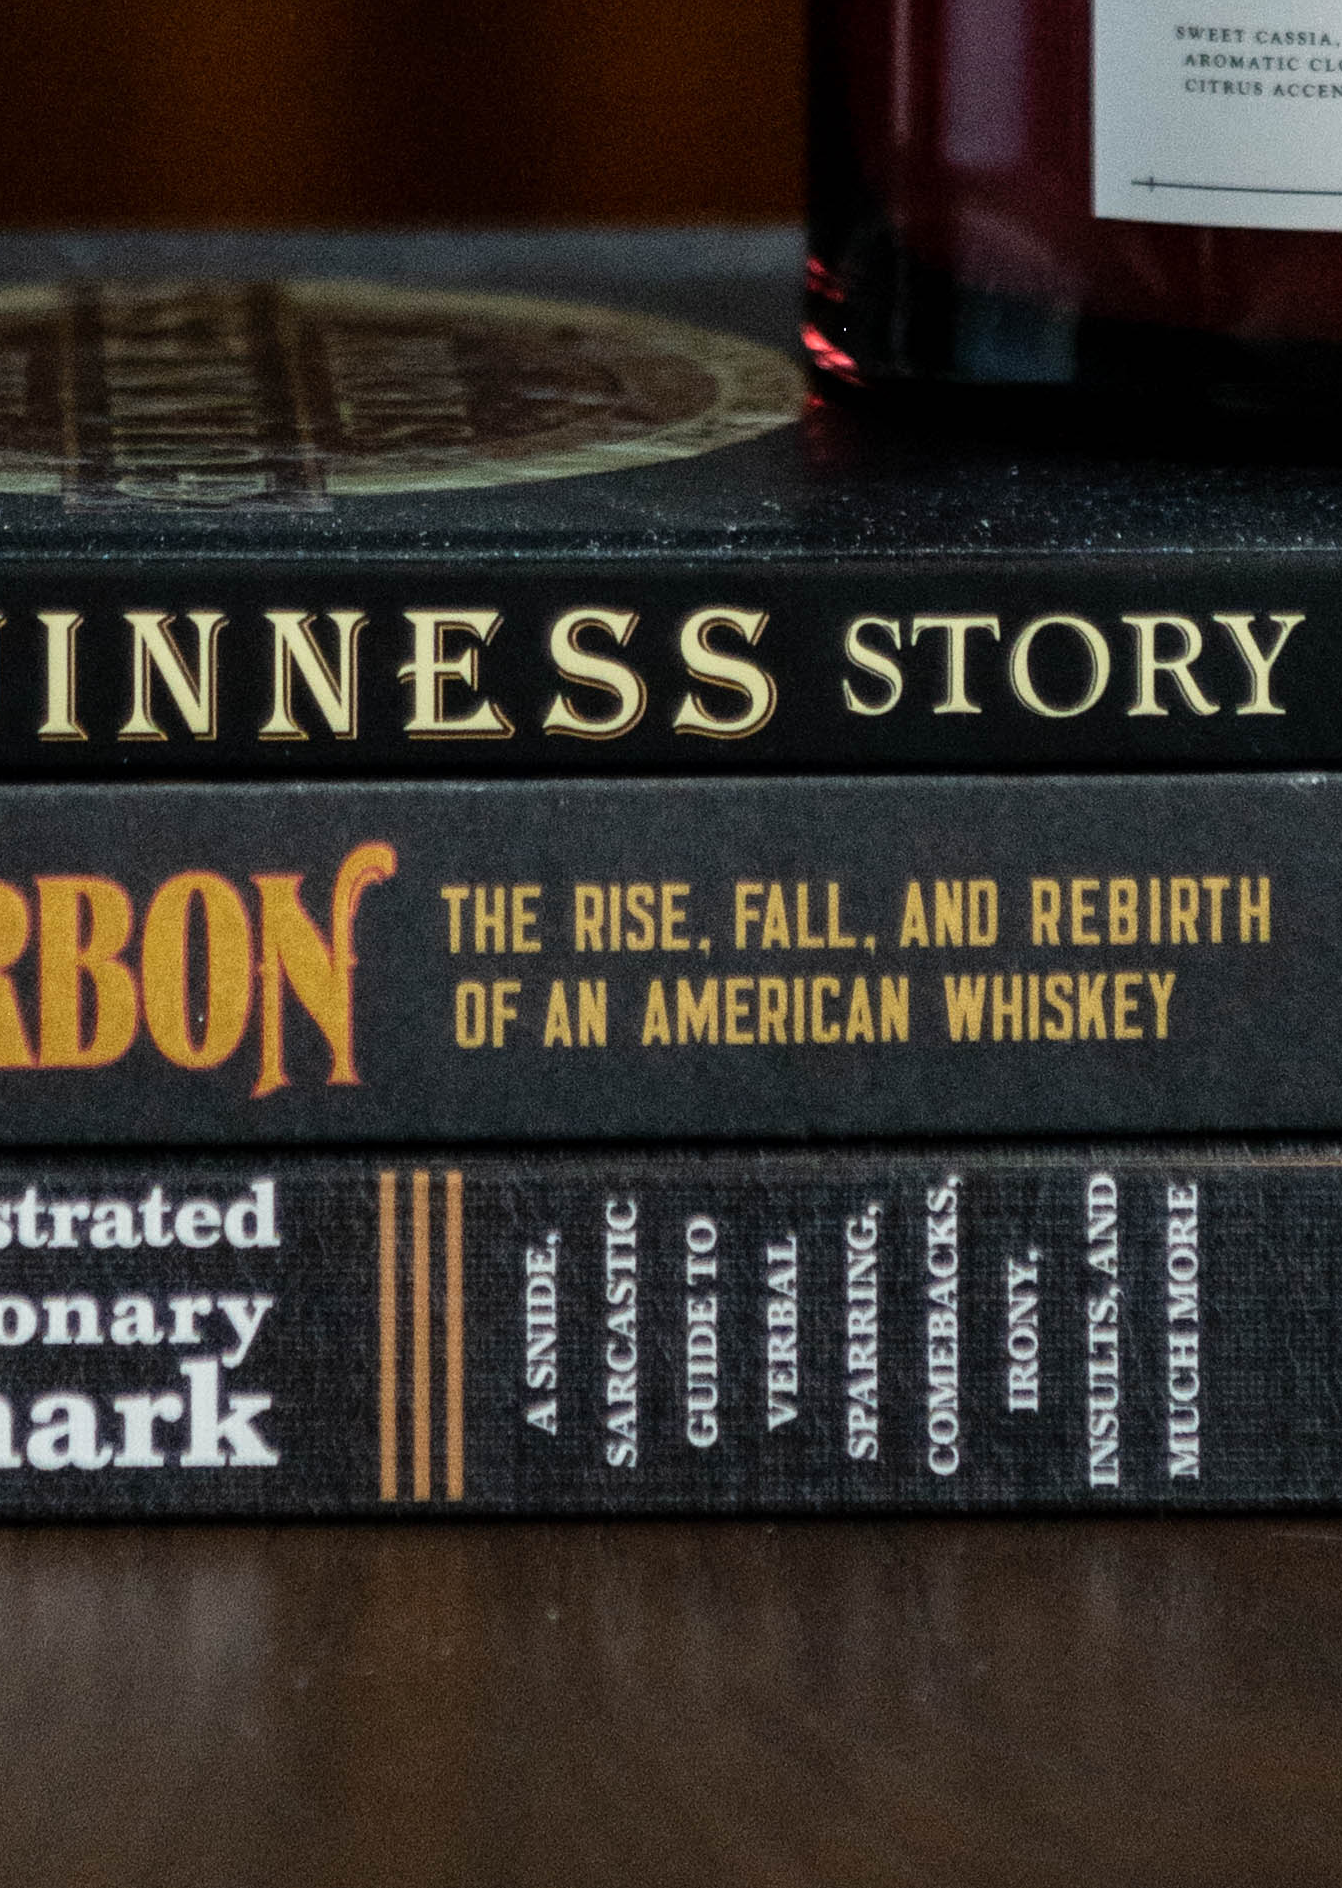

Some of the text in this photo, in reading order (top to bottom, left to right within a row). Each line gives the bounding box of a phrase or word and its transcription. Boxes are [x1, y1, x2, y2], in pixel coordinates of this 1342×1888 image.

[1176, 26, 1245, 45] SWEET
[1256, 30, 1341, 49] CASSIA,
[1184, 53, 1301, 73] AROMATIC
[1184, 78, 1263, 96] CITRUS
[842, 613, 1308, 718] STORY
[442, 875, 1273, 960] THE RISE, FALL, AND REBIRTH
[455, 972, 1177, 1049] OF AN AMERICAN WHISKEY
[526, 1230, 563, 1436] A SNIDE,
[605, 1199, 638, 1469] SARCASTIC
[685, 1215, 719, 1449] GUIDE TO
[766, 1231, 799, 1432] VERBAL
[846, 1200, 885, 1462] SPARRING,
[927, 1172, 964, 1477] COMEBACKS,
[1007, 1246, 1044, 1414] IRONY,
[1087, 1172, 1125, 1489] INSULTS, AND
[1167, 1183, 1201, 1480] MUCH MORE
